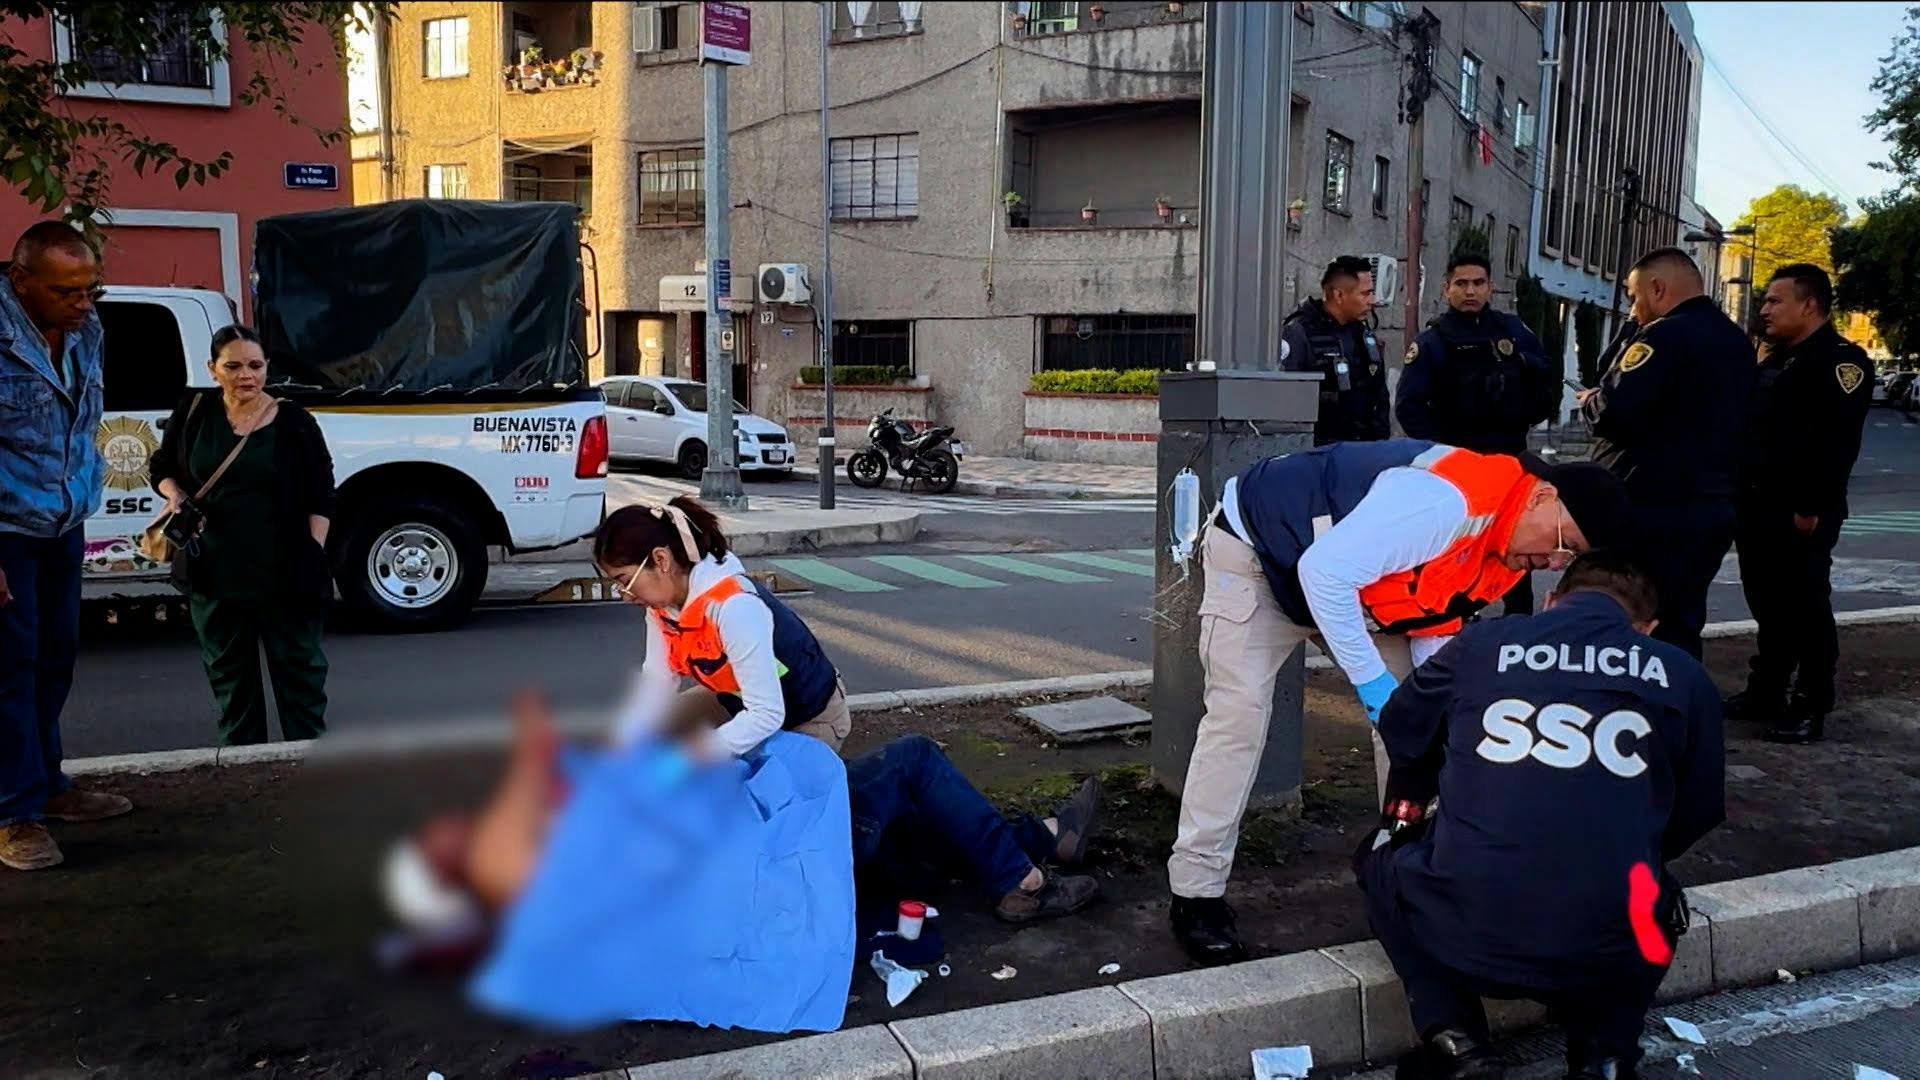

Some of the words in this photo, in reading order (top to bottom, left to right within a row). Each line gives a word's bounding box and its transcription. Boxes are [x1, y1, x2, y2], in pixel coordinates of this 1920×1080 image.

[684, 285, 697, 297] 12
[473, 416, 577, 433] BUENAVISTA
[105, 497, 153, 514] SSC
[1497, 643, 1670, 689] POLICÍA
[1475, 698, 1653, 779] SSC
